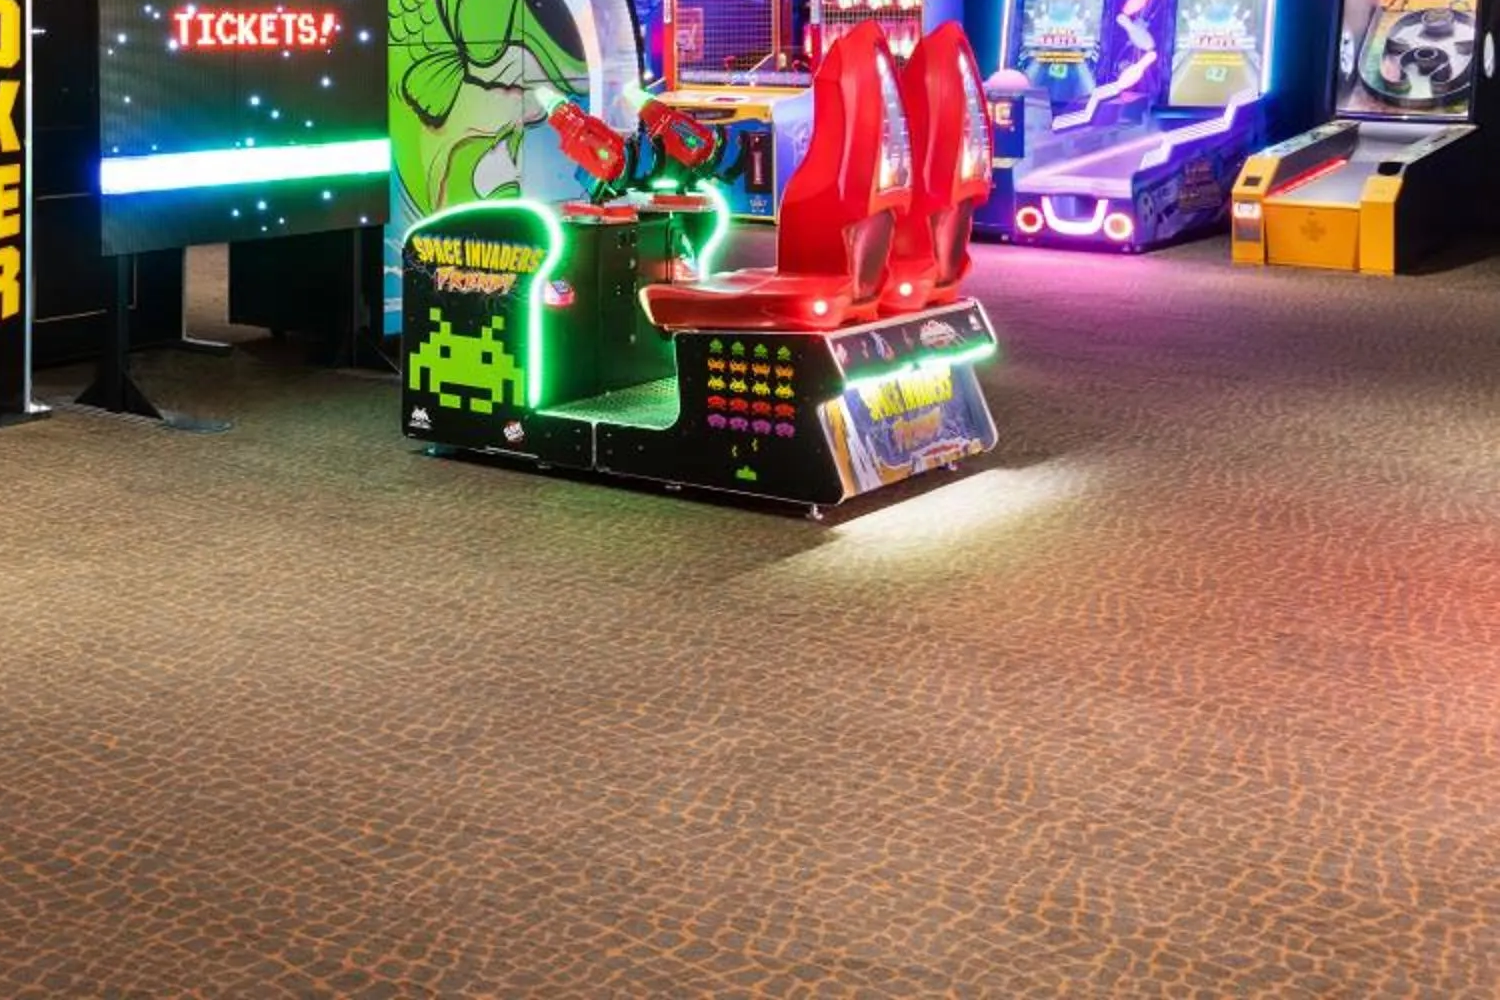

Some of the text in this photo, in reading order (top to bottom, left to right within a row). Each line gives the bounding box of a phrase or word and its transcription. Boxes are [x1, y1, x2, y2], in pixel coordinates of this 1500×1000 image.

[173, 12, 336, 46] TICKETS!
[413, 235, 544, 272] SPACE INVADERS
